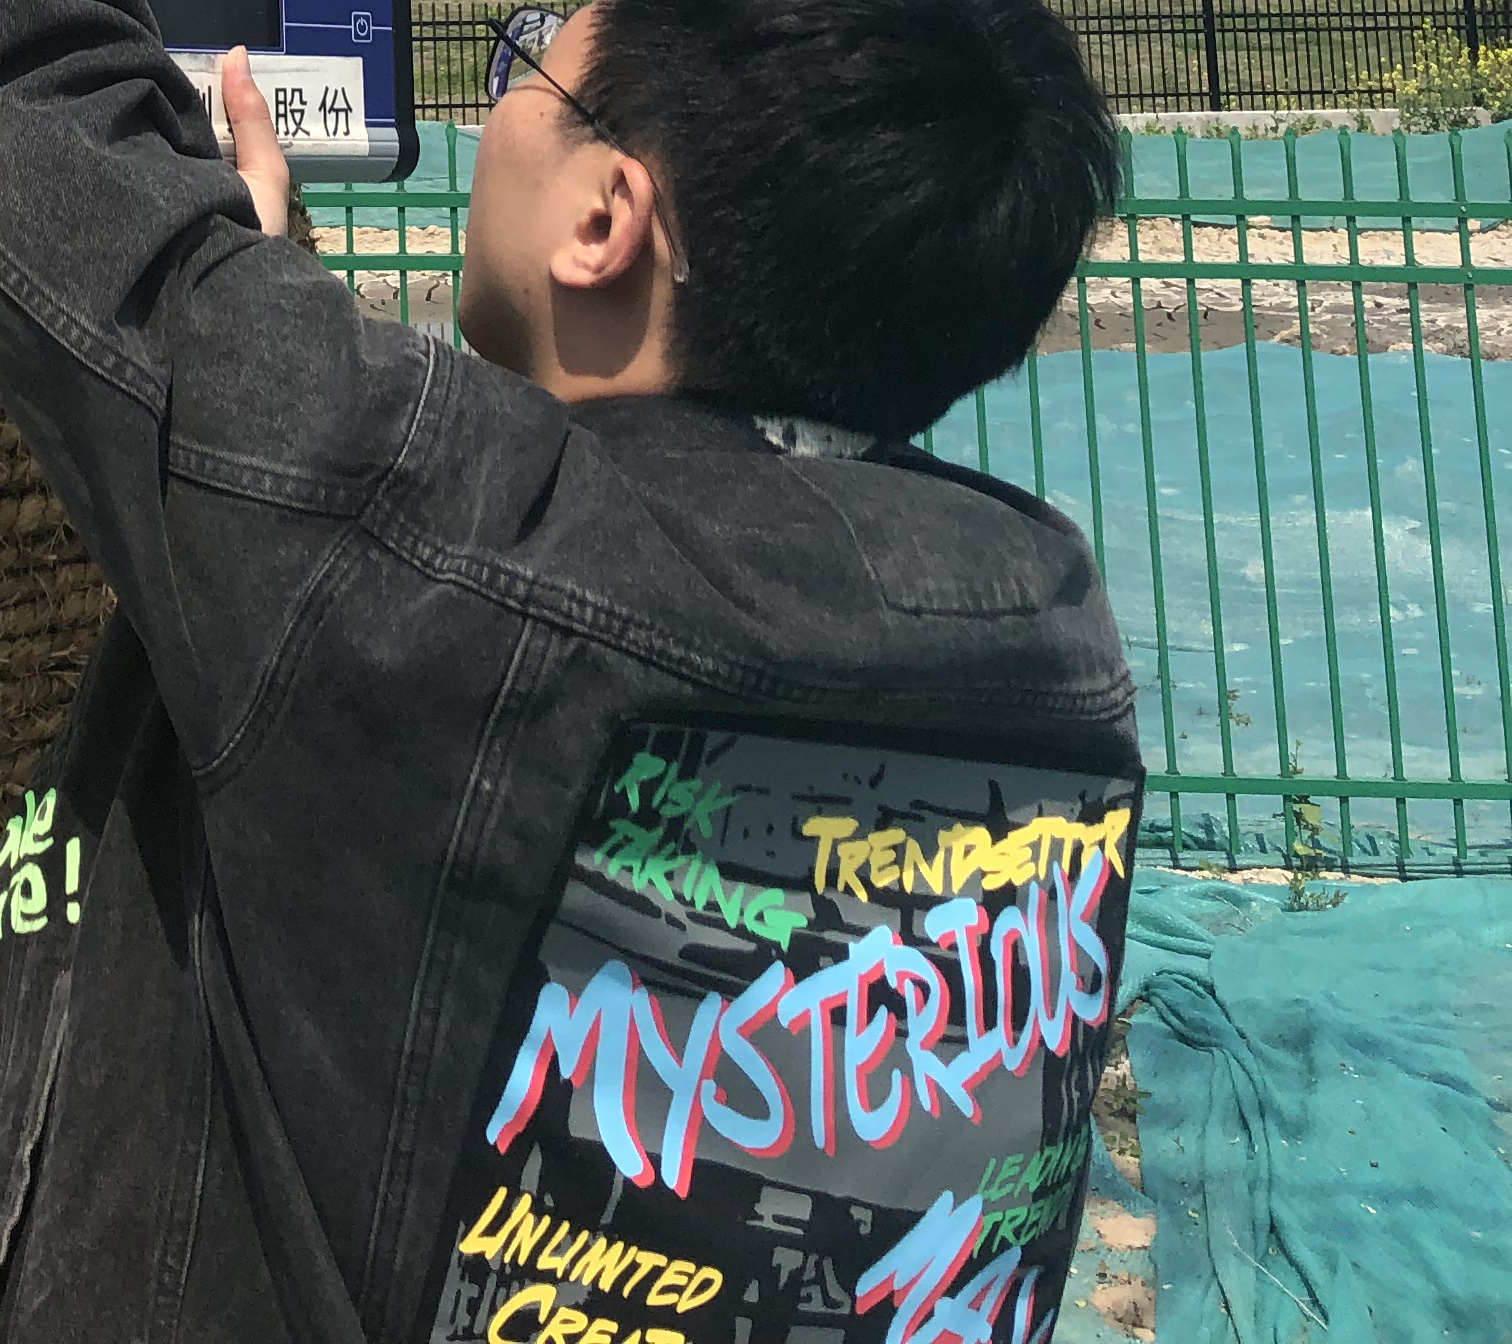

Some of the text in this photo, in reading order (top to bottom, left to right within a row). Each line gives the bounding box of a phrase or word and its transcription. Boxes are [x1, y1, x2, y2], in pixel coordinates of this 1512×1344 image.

[614, 752, 737, 839] RISK
[802, 808, 1131, 902] TRENDSETTER
[594, 819, 808, 952] TAKING
[487, 845, 1110, 1198] MYSTERIOUS
[458, 1186, 723, 1313] UNLIMITED
